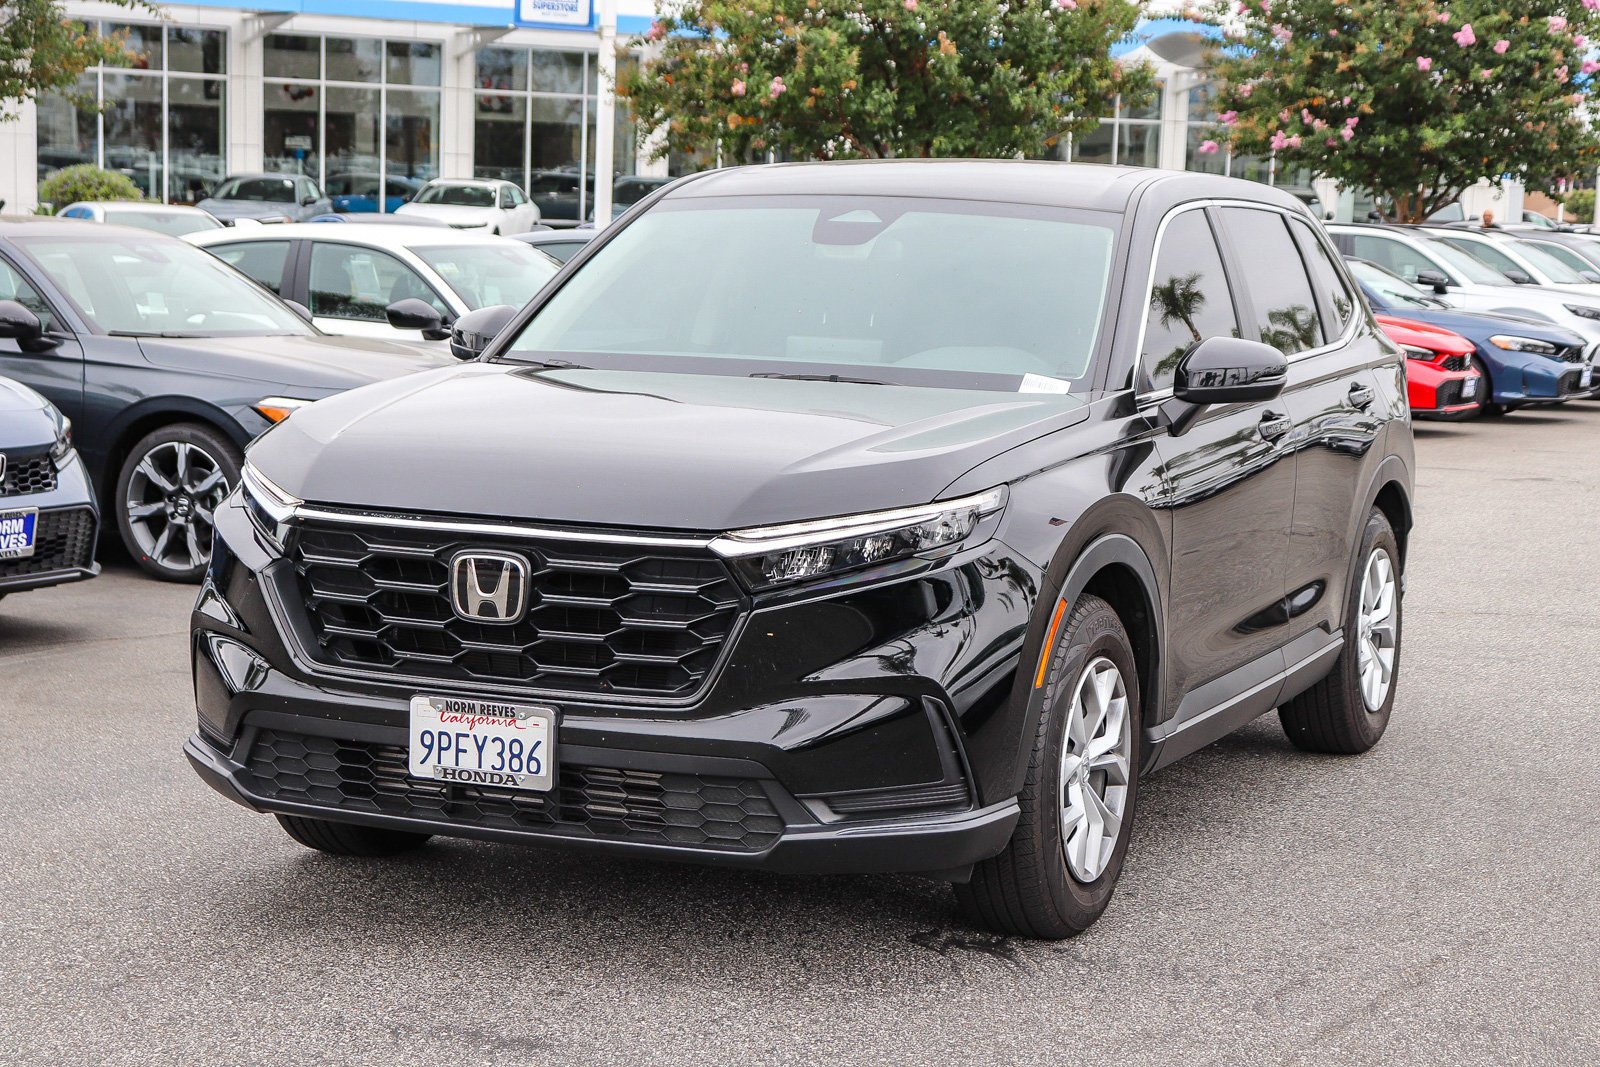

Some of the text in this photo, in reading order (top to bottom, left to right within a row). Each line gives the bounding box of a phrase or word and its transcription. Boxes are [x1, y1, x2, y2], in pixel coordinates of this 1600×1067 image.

[533, 1, 578, 12] SUPERSTORE
[0, 519, 24, 535] RM
[445, 700, 516, 718] NORM REEVES
[440, 711, 527, 731] California
[419, 729, 542, 775] 9PFY386
[441, 767, 519, 786] HONDA
